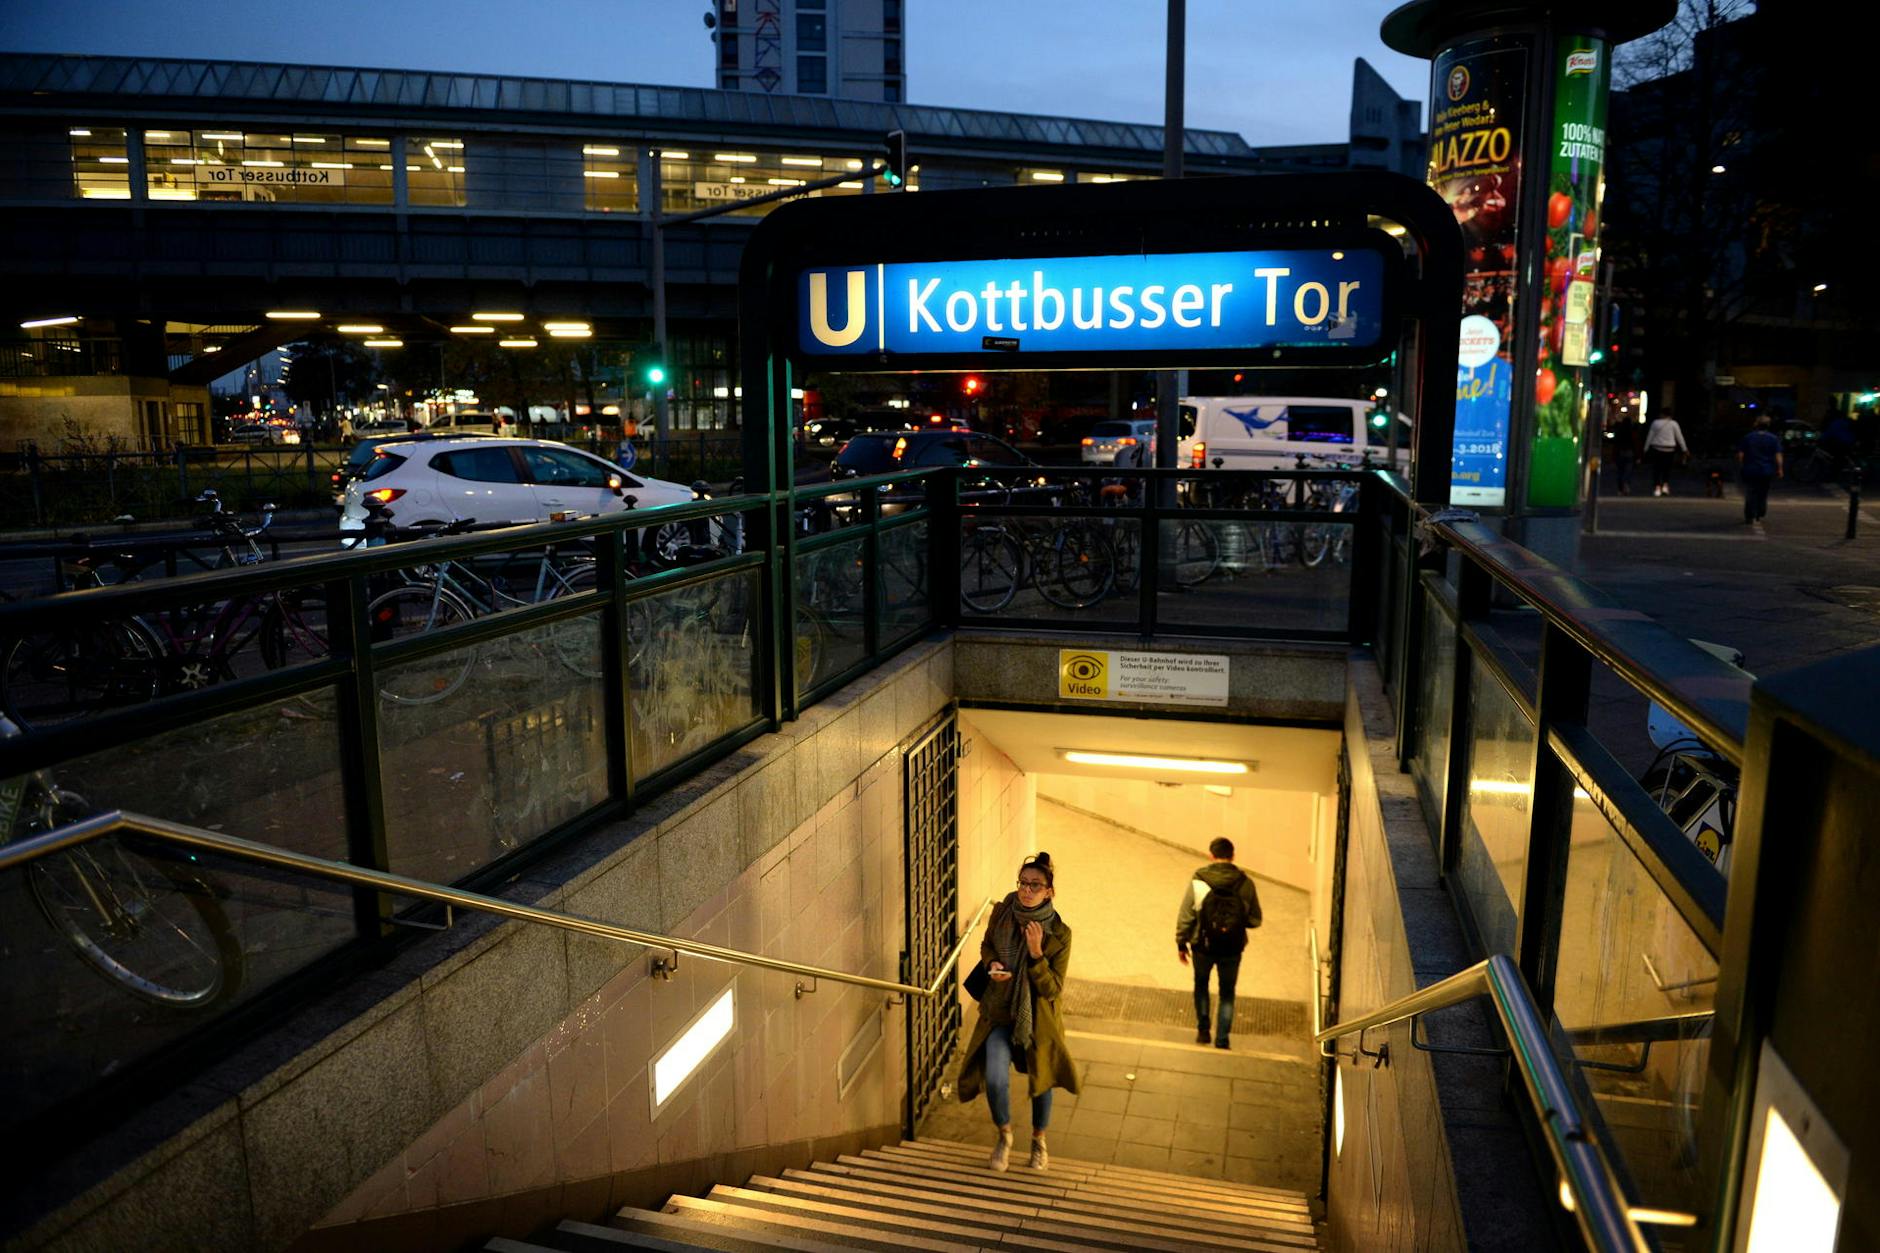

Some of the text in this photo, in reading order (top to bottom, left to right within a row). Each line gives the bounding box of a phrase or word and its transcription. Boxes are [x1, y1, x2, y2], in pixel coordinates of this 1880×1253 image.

[1562, 122, 1591, 143] 100%
[808, 267, 1361, 348] U Kottbusser Tor
[1120, 655, 1141, 663] Dieser
[1120, 663, 1152, 671] Sicherheit
[1166, 665, 1186, 673] Video
[1067, 682, 1102, 695] Video
